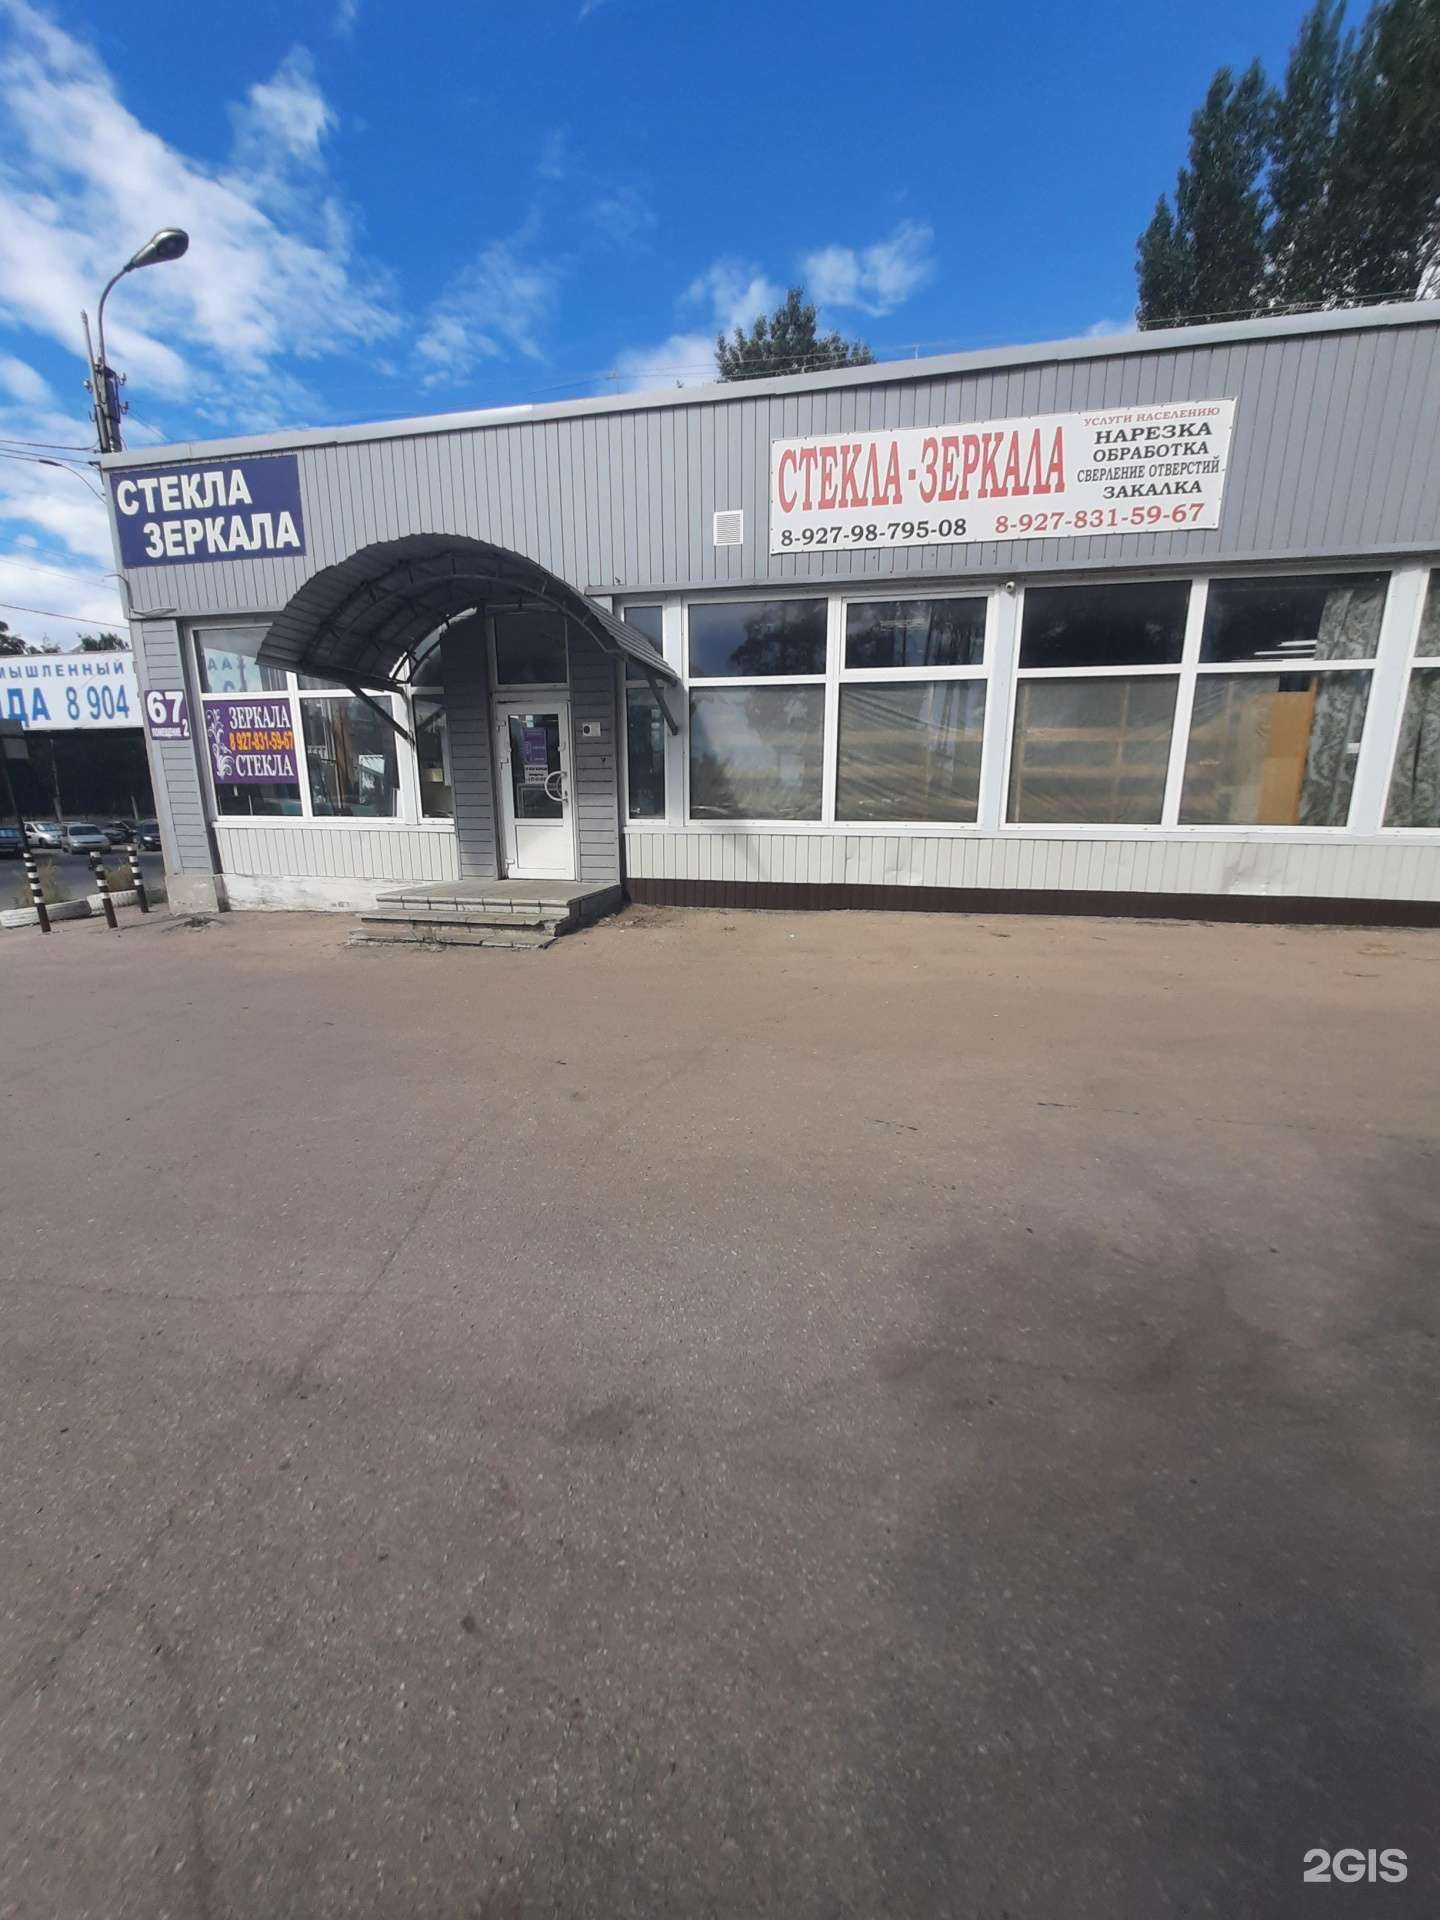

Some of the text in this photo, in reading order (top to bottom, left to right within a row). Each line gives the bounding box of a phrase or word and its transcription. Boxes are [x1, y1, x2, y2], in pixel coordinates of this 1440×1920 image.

[1084, 407, 1220, 427] УСЛУГИ НАСЕЛЕНИЮ
[1094, 422, 1213, 445] НАРЕЗКА
[1093, 441, 1209, 462] ОБРАБОТКА
[1077, 455, 1220, 483] СВЕРЛЕНИЕ ОТВЕРСТИЙ
[117, 469, 253, 516] СТЕКЛА
[1103, 480, 1202, 499] ЗАКАЛКА
[781, 518, 967, 547] 8-927-98-795-08
[994, 503, 1205, 534] 8-927-831-59-67
[143, 511, 301, 558] ЗЕРКАЛА
[0, 684, 130, 728] ДА 8 904
[147, 691, 183, 724] 67
[229, 705, 291, 729] ЗЕРКАЛА
[235, 754, 294, 777] СТЕКЛА
